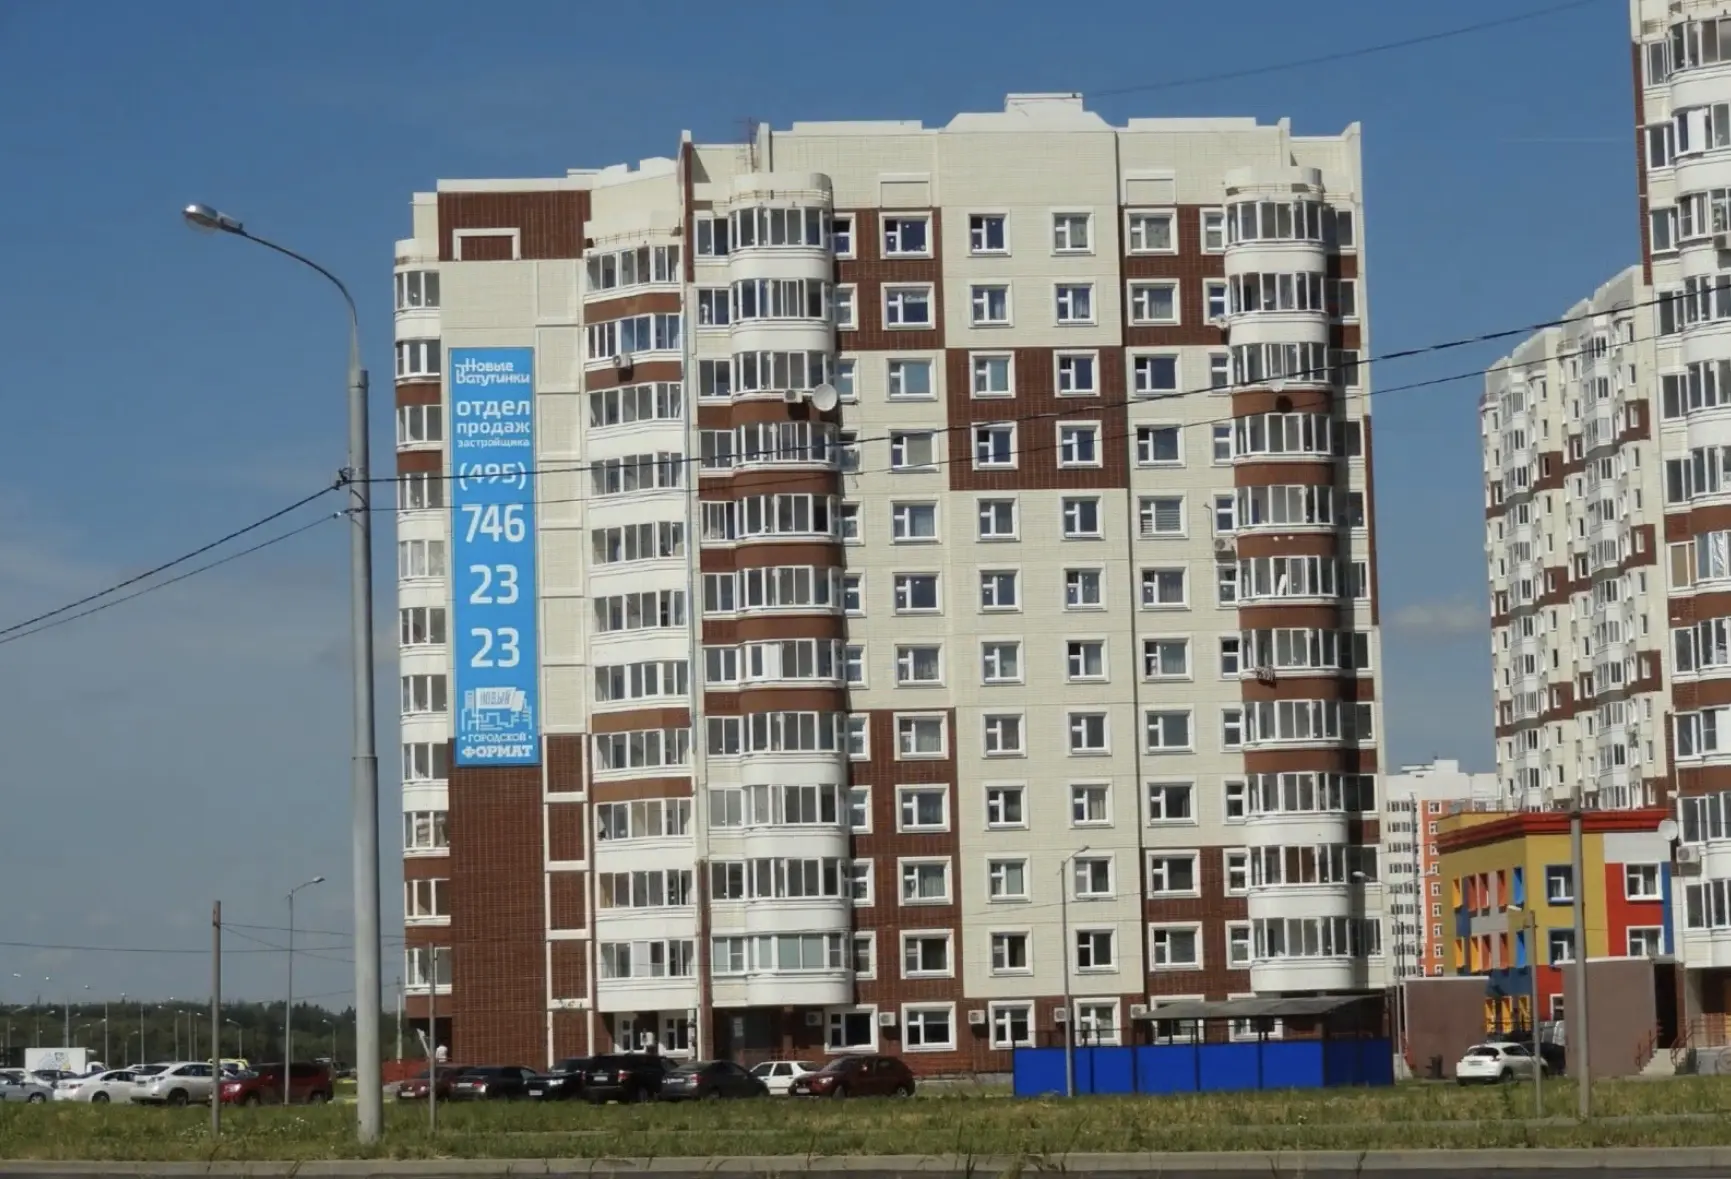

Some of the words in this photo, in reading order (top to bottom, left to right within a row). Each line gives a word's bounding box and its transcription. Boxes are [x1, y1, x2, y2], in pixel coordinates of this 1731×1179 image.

[454, 357, 514, 372] Новые
[456, 400, 531, 419] отдел
[456, 421, 531, 437] продаж
[457, 437, 530, 448] застройщика
[459, 461, 526, 491] (495)
[461, 503, 526, 543] 746
[469, 564, 519, 604] 23
[471, 627, 520, 667] 23
[462, 745, 533, 758] ФОРМАТ
